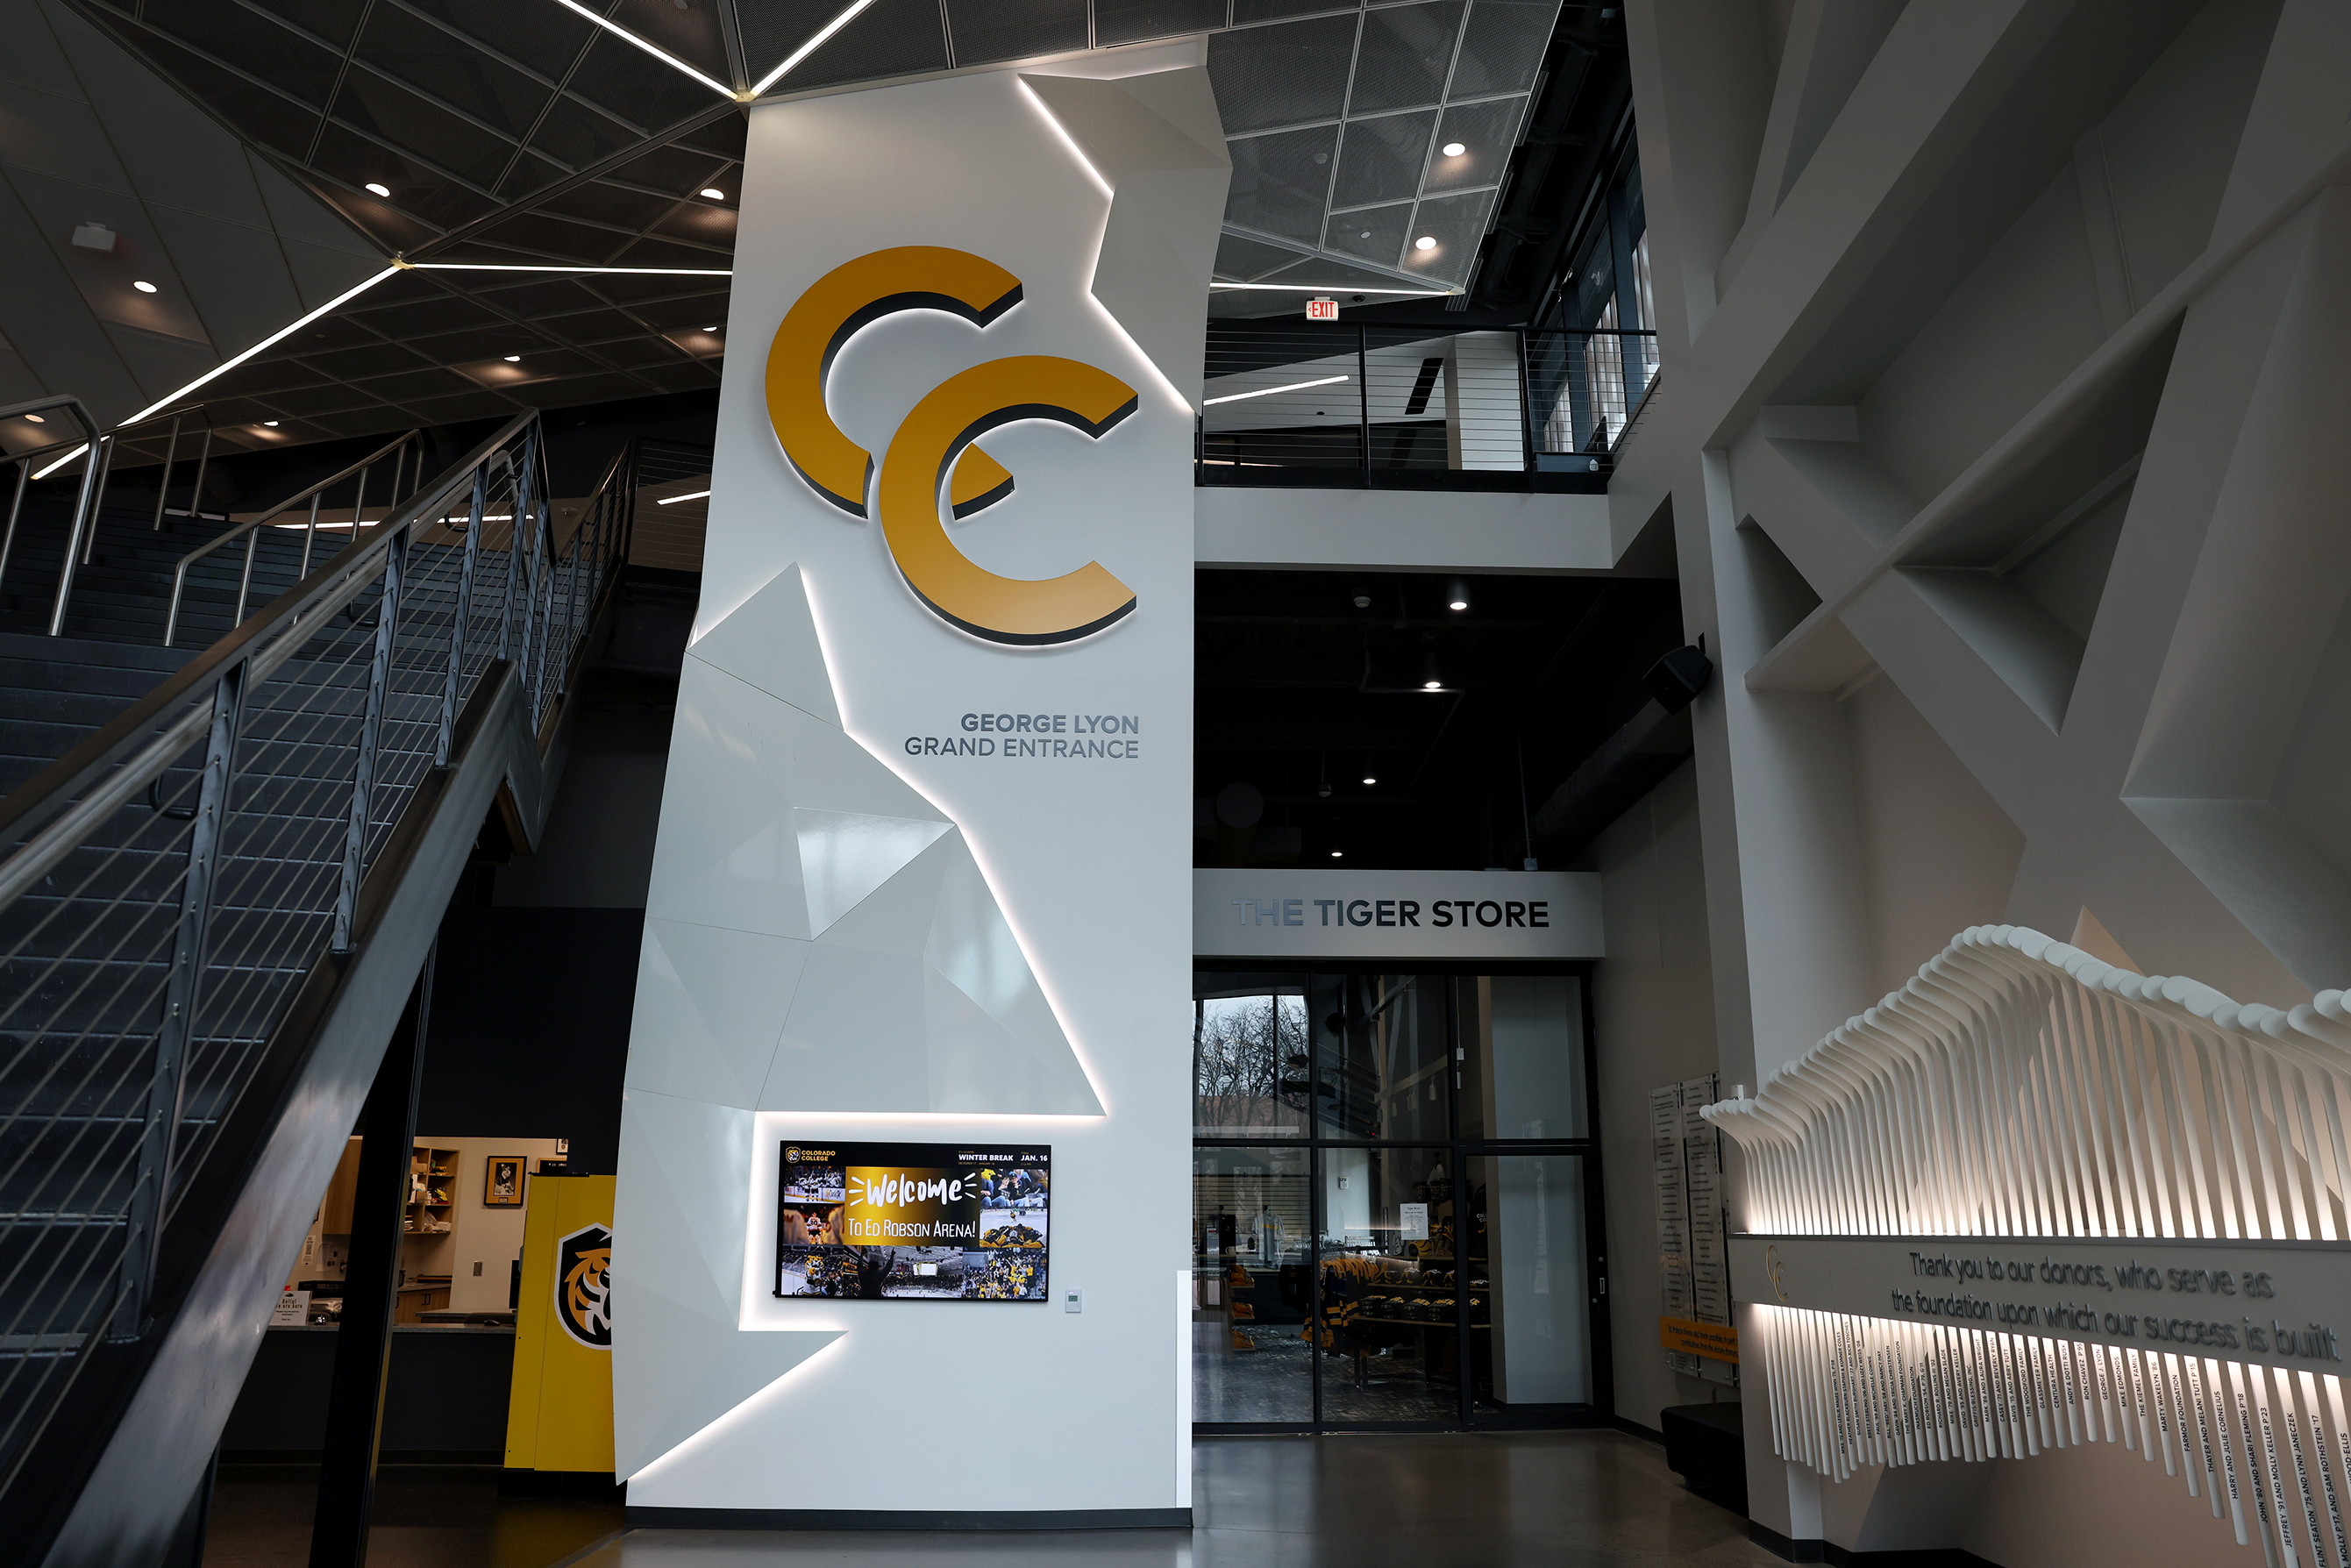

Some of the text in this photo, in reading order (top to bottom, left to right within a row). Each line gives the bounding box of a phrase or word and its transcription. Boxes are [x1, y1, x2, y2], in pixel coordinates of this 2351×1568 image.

[1312, 302, 1335, 317] EXIT
[961, 713, 1139, 736] GEORGE LYON
[904, 737, 1139, 759] GRAND ENTRANCE
[1232, 899, 1550, 928] THE TIGER STORE
[1910, 1252, 2276, 1299] Thank you to our donors, who serve as
[1892, 1288, 1913, 1312] the
[1916, 1290, 1994, 1321] foundation
[1997, 1302, 2041, 1329] upon
[2044, 1301, 2101, 1333] which
[2105, 1312, 2138, 1337] our
[2144, 1315, 2241, 1350] success
[2243, 1316, 2269, 1352] is
[2079, 1359, 2088, 1385] CHAVEZ
[2114, 1357, 2125, 1390] EDMONDS
[2020, 1369, 2030, 1405] WOODFORD
[2035, 1369, 2046, 1409] GLASSMEYER
[2051, 1379, 2060, 1408] CENTURA
[2099, 1374, 2108, 1401] GEORGE
[2154, 1374, 2163, 1406] WAKELYN
[2159, 1408, 2168, 1432] MARTY
[2173, 1374, 2191, 1451] FARMOR FOUNDATION
[2196, 1398, 2205, 1425] MELANI
[2214, 1391, 2226, 1432] CORNELIUS
[2241, 1410, 2252, 1443] FLEMING
[2263, 1425, 2274, 1453] KELLER
[2287, 1412, 2301, 1452] JANECZEK
[2221, 1434, 2231, 1454] JULIE
[2248, 1444, 2257, 1467] SHARI
[2314, 1428, 2329, 1472] ROTHSTEIN
[2204, 1444, 2215, 1472] THAYER
[2269, 1455, 2279, 1480] MOLLY
[2296, 1454, 2305, 1475] LYNN
[2340, 1433, 2351, 1485] OOD-ELLIS
[2228, 1473, 2239, 1500] HARRY
[2252, 1469, 2261, 1486] AND
[2274, 1482, 2283, 1500] AND
[2300, 1477, 2310, 1495] AND
[2324, 1474, 2333, 1492] SAM
[2258, 1501, 2269, 1524] JOHN
[2328, 1494, 2338, 1513] AND
[2280, 1514, 2292, 1548] JEFFREY
[2308, 1510, 2321, 1543] SEATON
[2315, 1545, 2326, 1568] FLINT
[2337, 1534, 2349, 1562] MOLLY
